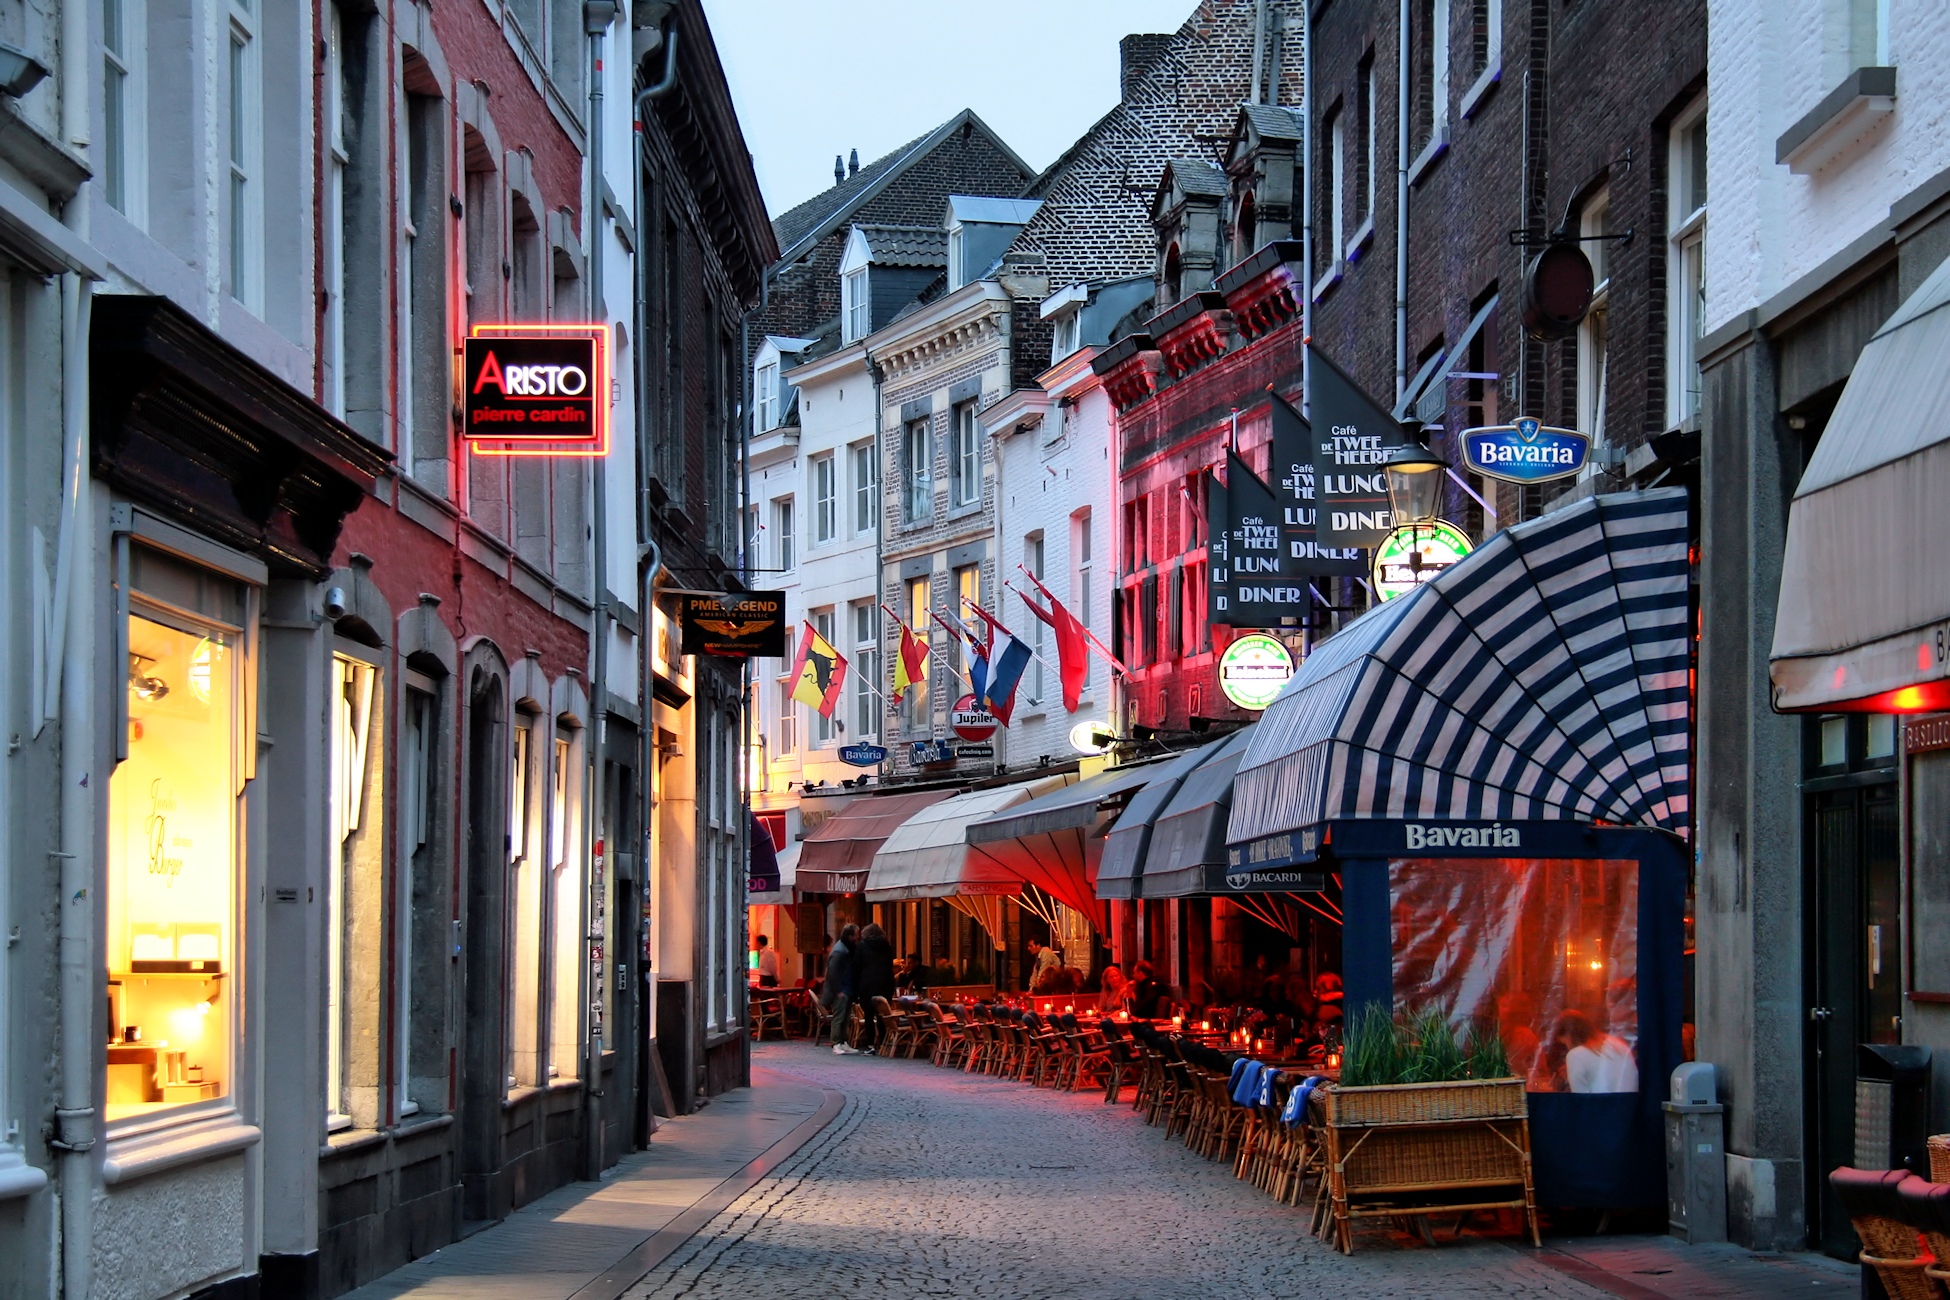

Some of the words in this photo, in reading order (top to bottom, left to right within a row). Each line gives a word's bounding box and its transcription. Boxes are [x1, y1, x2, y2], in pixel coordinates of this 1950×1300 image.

[473, 350, 587, 395] ARISTO
[473, 406, 525, 424] pierre
[529, 406, 585, 422] cardin
[1331, 425, 1357, 435] Café
[1321, 443, 1334, 452] DE
[1331, 436, 1381, 450] TWEE
[1480, 442, 1574, 464] Bavaria
[1291, 464, 1314, 473] Café
[1282, 479, 1293, 487] DE
[1242, 517, 1264, 525] Café
[1239, 587, 1301, 603] DINER
[690, 600, 720, 610] PME
[735, 601, 778, 612] GEND
[956, 713, 995, 724] Jupiler
[845, 750, 882, 760] Bavaria
[1405, 823, 1520, 849] Bavaria
[1252, 873, 1302, 882] BACARDI
